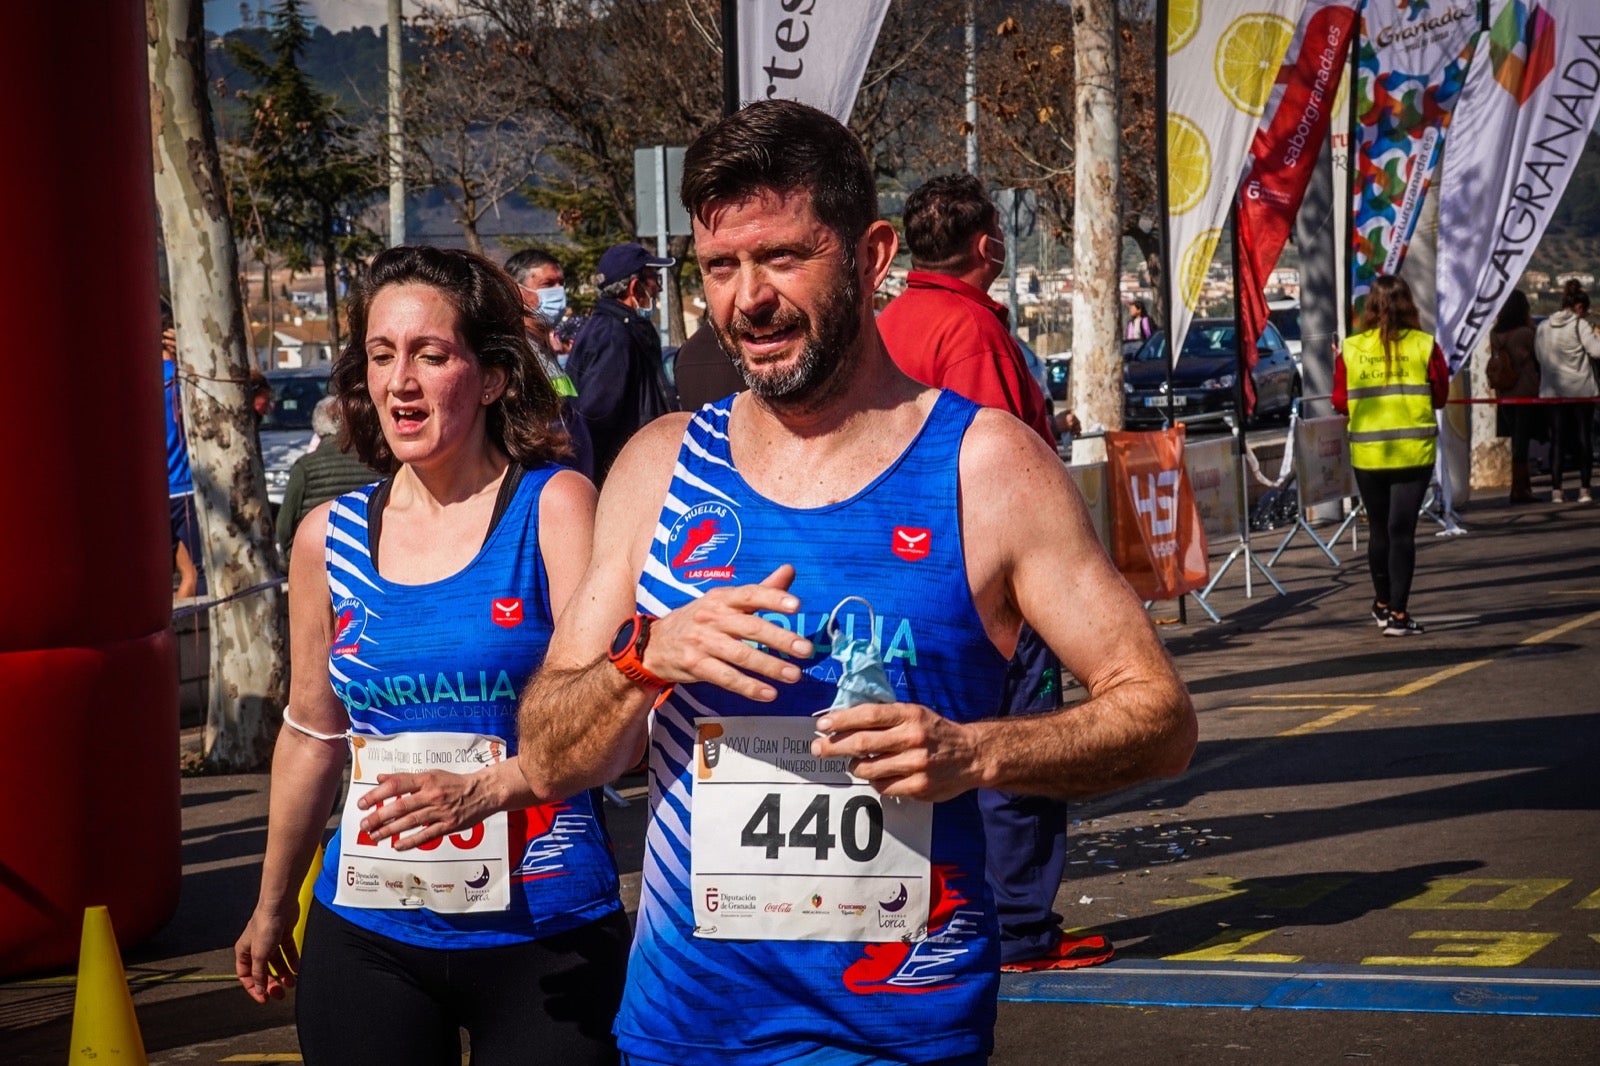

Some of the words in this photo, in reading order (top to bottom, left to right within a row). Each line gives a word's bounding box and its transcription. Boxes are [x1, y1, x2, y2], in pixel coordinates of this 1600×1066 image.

[1376, 5, 1472, 47] Granada
[1284, 25, 1341, 168] saborgranada.es
[1387, 135, 1435, 267] www.turgranada.es
[684, 505, 727, 522] HUELLAS
[335, 670, 517, 713] SONRIALIA
[724, 737, 749, 754] XXXV
[741, 793, 884, 862] 440
[720, 893, 756, 903] Diputación
[728, 902, 756, 910] Granada
